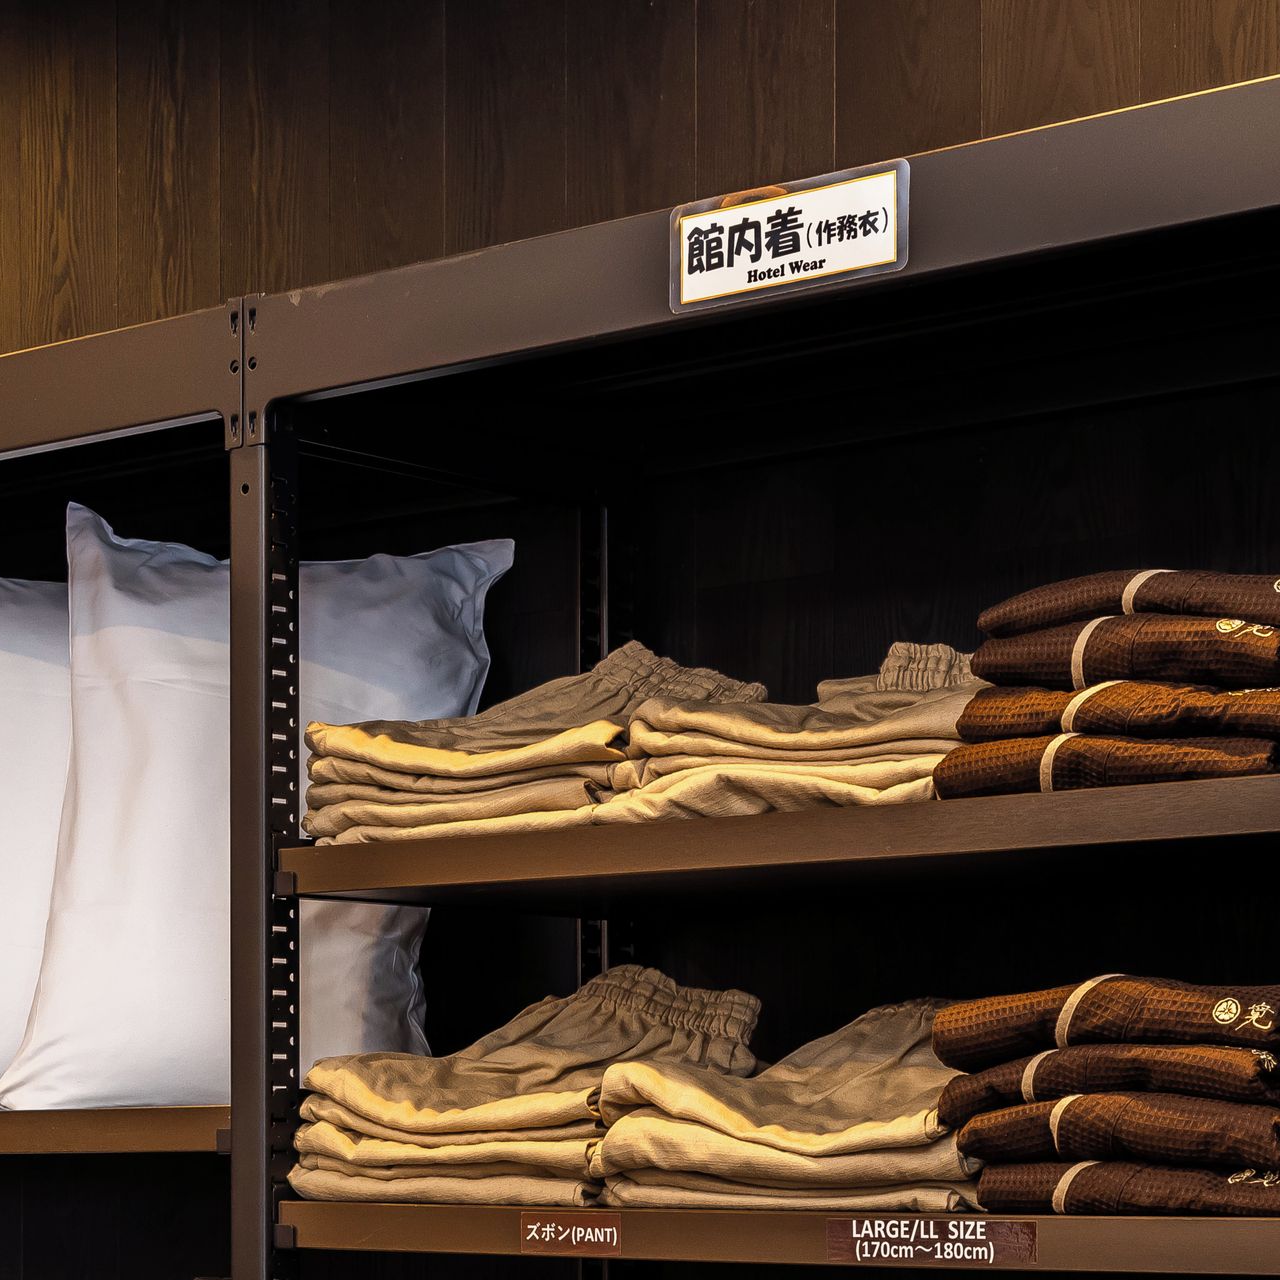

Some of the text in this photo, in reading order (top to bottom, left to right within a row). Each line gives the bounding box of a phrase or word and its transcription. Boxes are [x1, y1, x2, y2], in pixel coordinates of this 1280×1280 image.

[687, 206, 888, 276] 館内着(作務衣)
[747, 258, 826, 284] Hotel Wear
[526, 1222, 618, 1246] ズボン(PANT)
[852, 1218, 987, 1241] LARGE/LL SIZE
